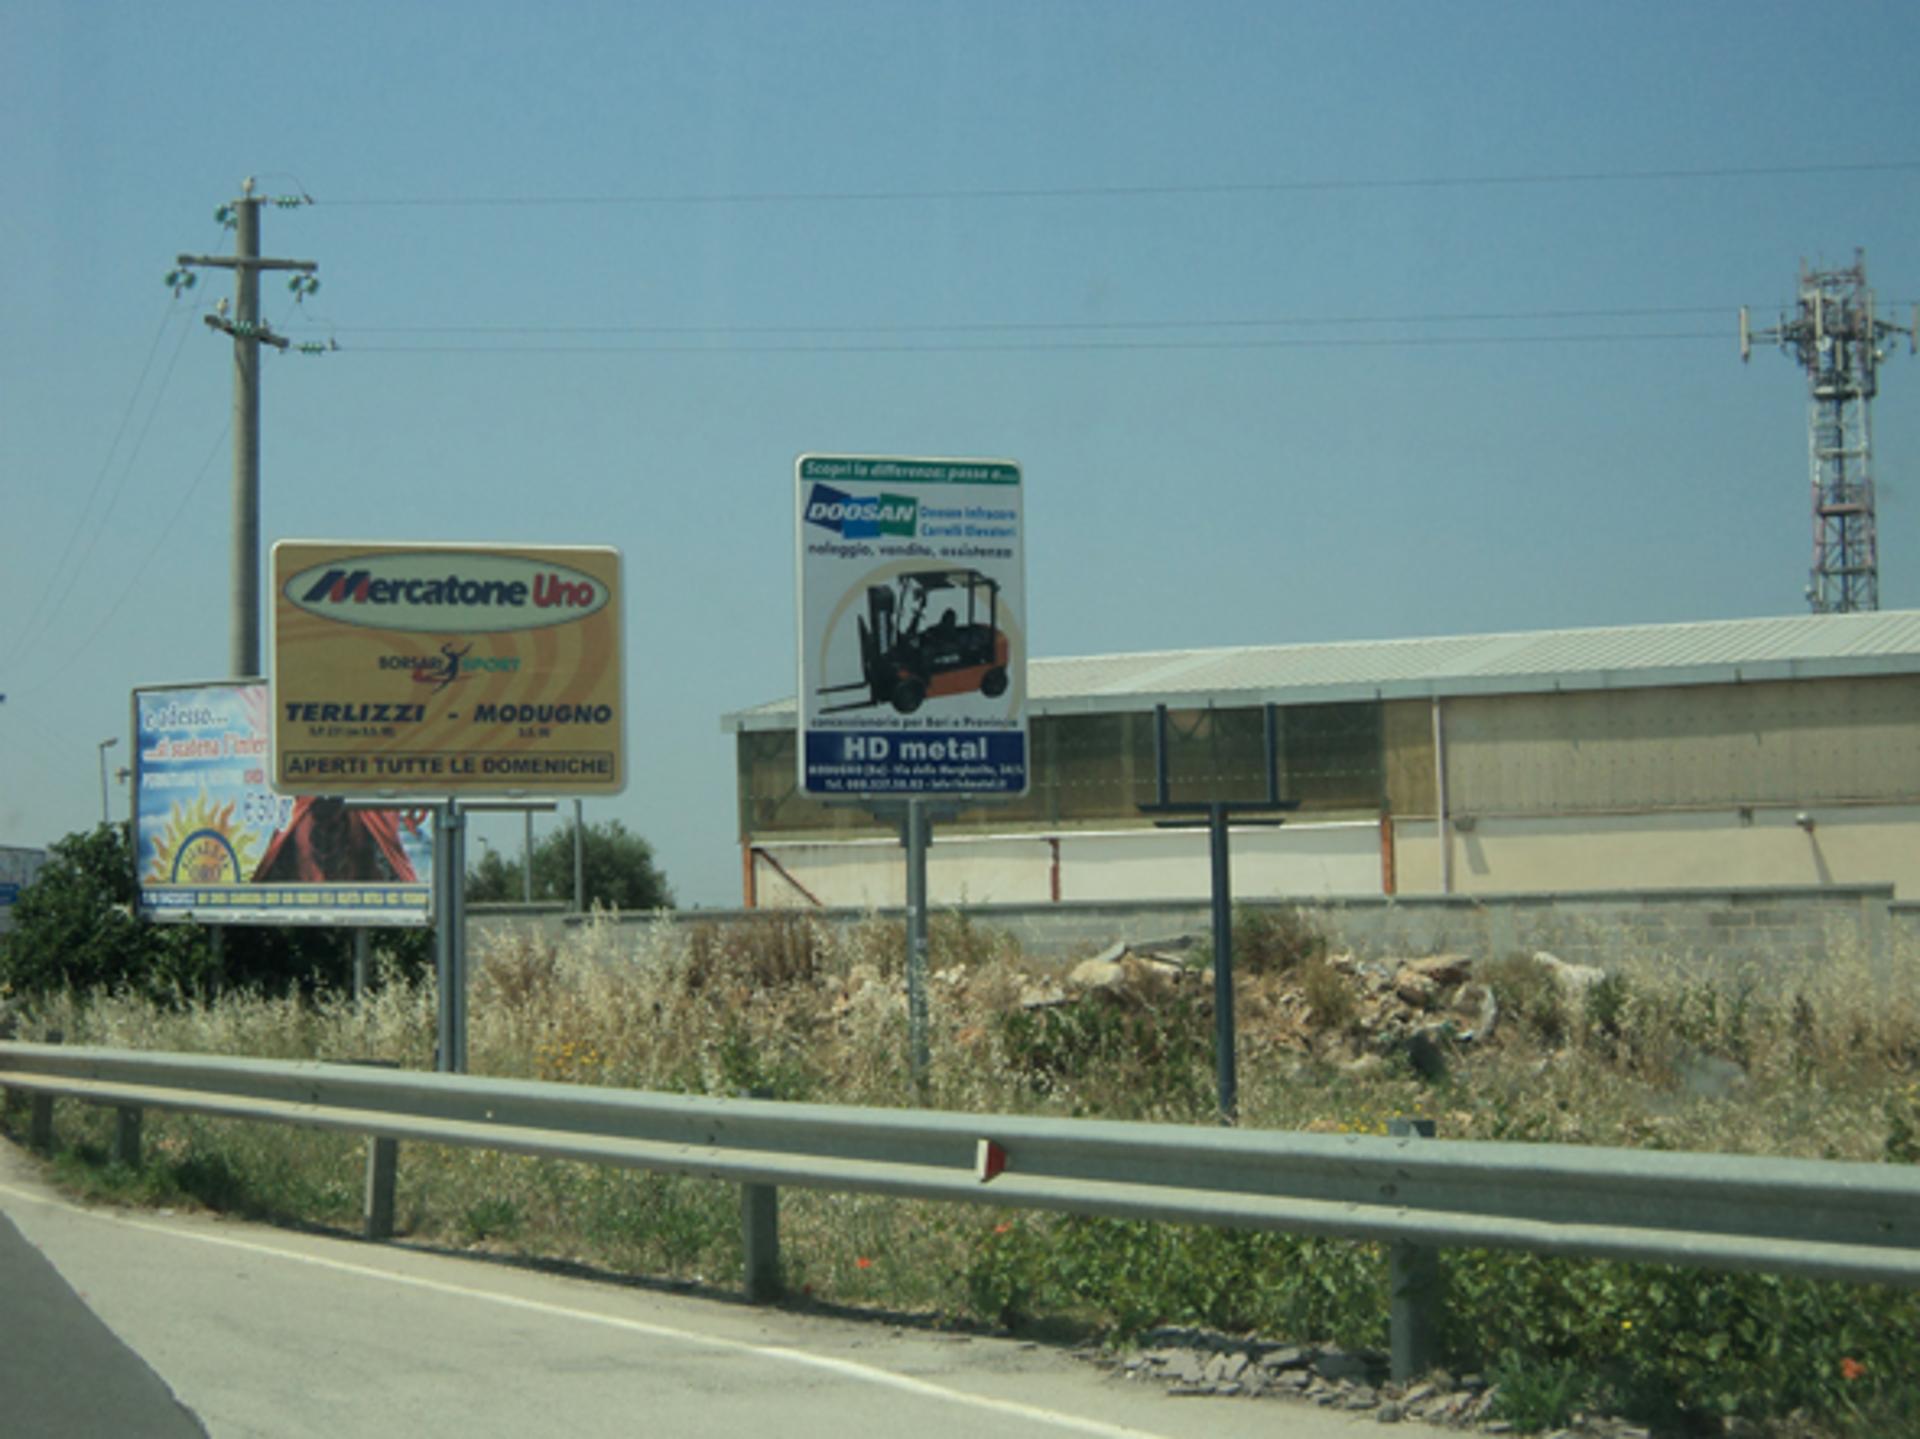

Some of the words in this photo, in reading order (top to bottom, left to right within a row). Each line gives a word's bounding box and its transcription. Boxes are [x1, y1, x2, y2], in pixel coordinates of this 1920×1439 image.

[806, 461, 850, 478] Scopri
[853, 463, 867, 476] la
[809, 502, 915, 521] DOOSAN
[808, 541, 875, 558] noleggio,
[879, 543, 936, 559] vendita,
[940, 544, 1013, 558] assistenza
[302, 569, 528, 607] Mercatone
[532, 572, 595, 608] Uno
[378, 656, 443, 671] BORSARI
[462, 656, 520, 673] SPORT
[286, 703, 426, 723] TERLIZZI
[473, 703, 613, 724] MODUGNO
[902, 718, 921, 729] per
[926, 715, 949, 727] Bari
[964, 715, 1018, 728] Provincia
[843, 736, 890, 760] HD
[899, 736, 988, 760] metal
[287, 756, 368, 775] APERTI
[374, 756, 444, 774] TUTTE
[450, 757, 475, 774] LE
[482, 757, 609, 775] DOMENICHE
